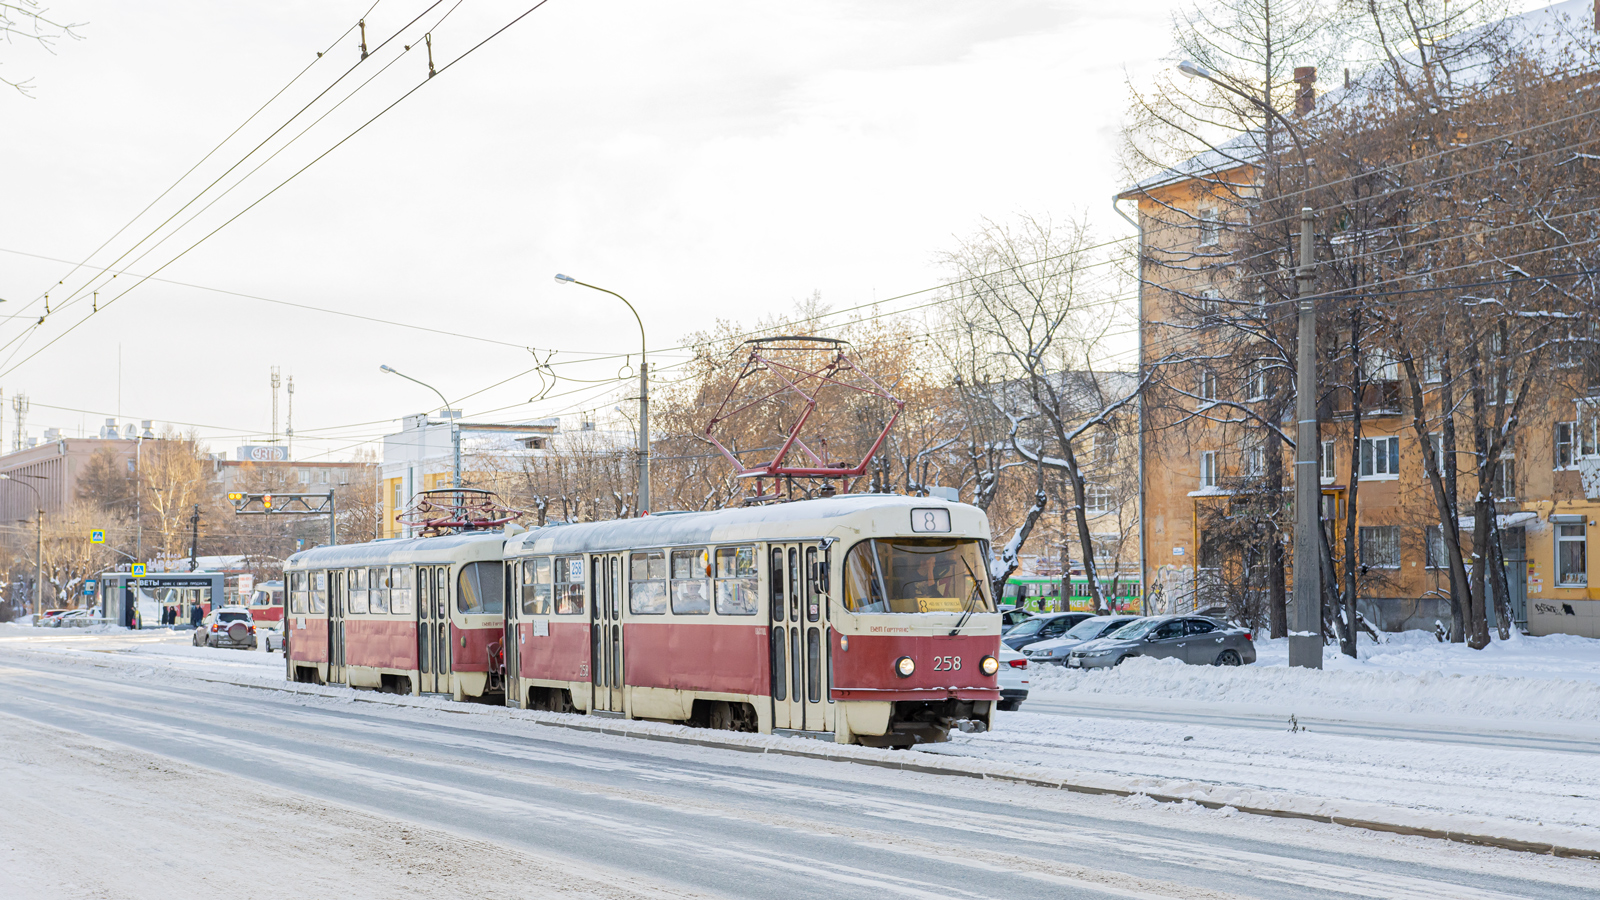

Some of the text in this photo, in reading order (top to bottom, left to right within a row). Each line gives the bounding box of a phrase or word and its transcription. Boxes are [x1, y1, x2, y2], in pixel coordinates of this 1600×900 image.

[924, 511, 936, 531] 8
[571, 561, 582, 575] 258
[919, 600, 928, 612] 8
[933, 656, 962, 671] 258
